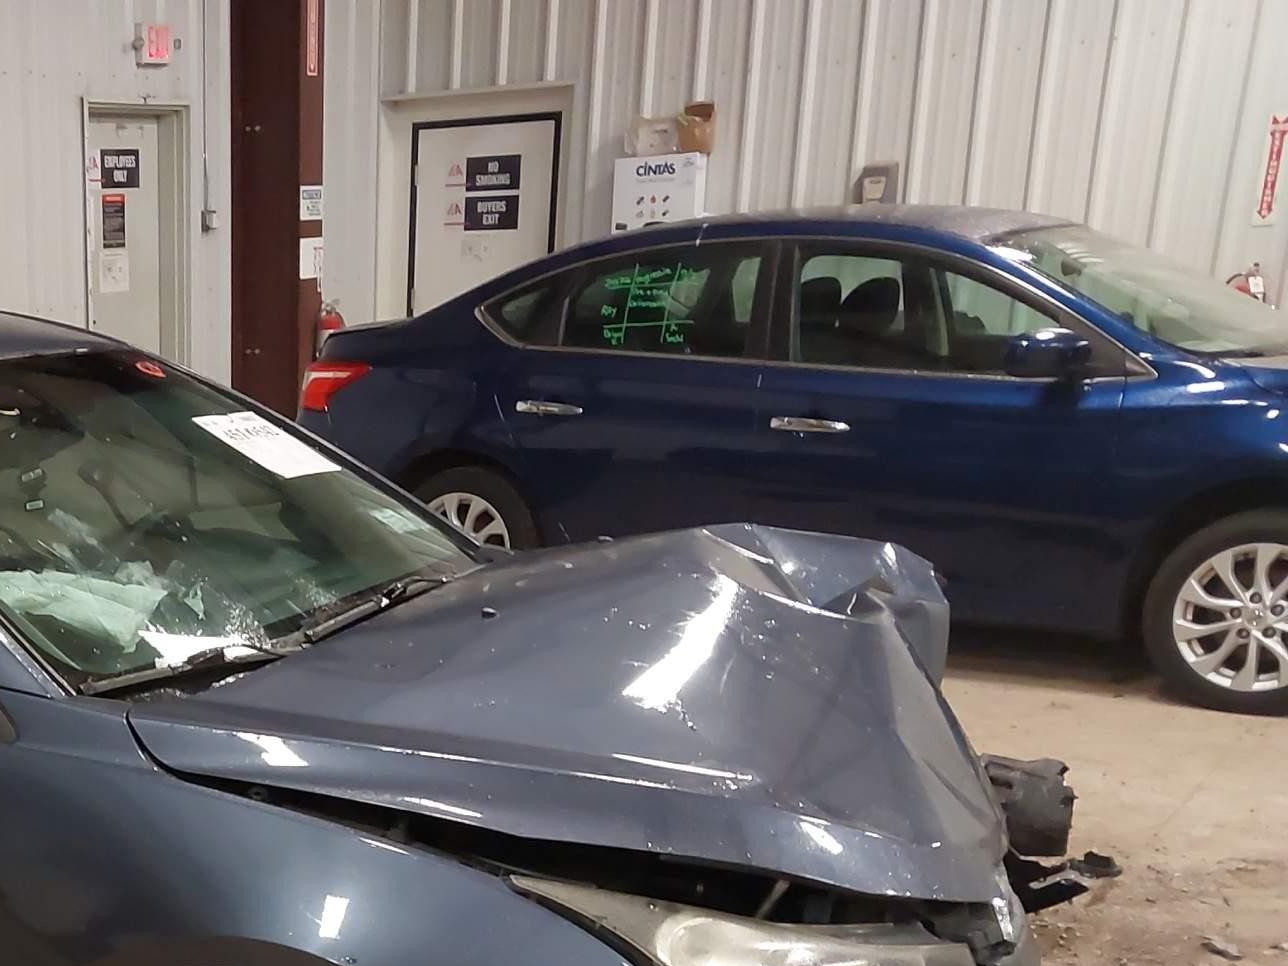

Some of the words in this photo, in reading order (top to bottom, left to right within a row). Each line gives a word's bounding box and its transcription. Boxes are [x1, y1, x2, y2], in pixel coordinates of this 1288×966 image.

[104, 155, 136, 168] EMPLOYEES
[488, 161, 500, 173] NO
[113, 169, 128, 183] ONLY
[475, 173, 511, 186] SMOKING
[477, 201, 507, 213] BUYERS
[482, 213, 499, 225] EXIT
